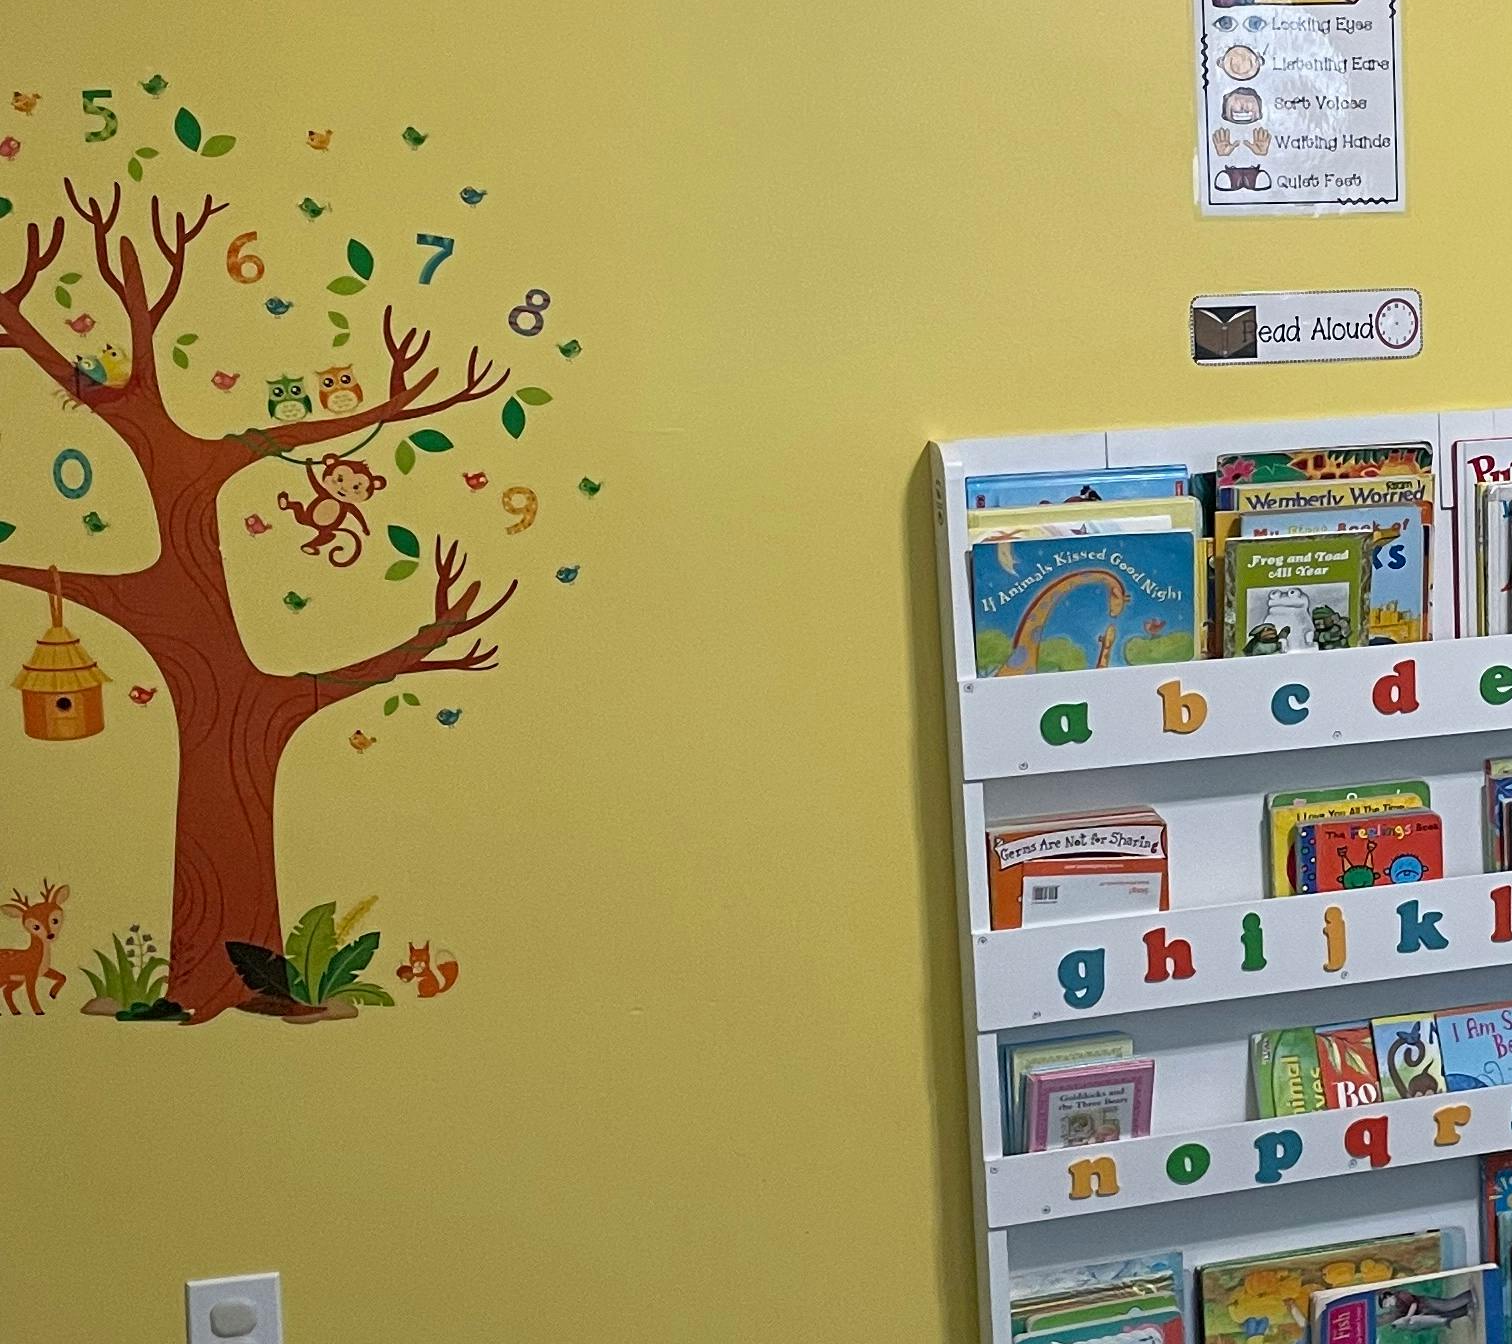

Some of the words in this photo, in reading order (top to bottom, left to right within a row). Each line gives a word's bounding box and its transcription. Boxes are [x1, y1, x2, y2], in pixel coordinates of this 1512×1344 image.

[82, 89, 118, 143] 5
[226, 231, 266, 284] 6
[416, 233, 455, 285] 7
[508, 288, 551, 337] 8
[1311, 314, 1375, 341] Aloud
[501, 486, 539, 535] 9
[1350, 486, 1426, 505] Worried
[999, 563, 1053, 605] Animals
[1053, 548, 1107, 567] Kissed
[1110, 552, 1146, 583] Good
[1141, 581, 1183, 602] Night
[1248, 554, 1283, 568] Frog
[1287, 552, 1311, 564] and
[1315, 550, 1349, 562] Toad
[1157, 680, 1208, 735] b
[1271, 683, 1310, 725] c
[1372, 660, 1419, 715] d
[1040, 702, 1093, 746] a
[1000, 843, 1036, 862] Germs
[1040, 837, 1061, 851] Are
[1065, 833, 1088, 848] Not
[1090, 832, 1107, 846] for
[1109, 831, 1159, 854] Sharing
[1350, 824, 1412, 840] Feelings
[1397, 899, 1449, 954] k
[1057, 947, 1105, 1009] g
[1143, 927, 1196, 984] h
[1452, 1023, 1459, 1042] I
[1467, 1018, 1495, 1039] Am
[1345, 1115, 1391, 1168] q
[1433, 1105, 1471, 1146] r
[1068, 1156, 1120, 1200] n
[1166, 1143, 1211, 1185] o
[1254, 1129, 1303, 1184] p
